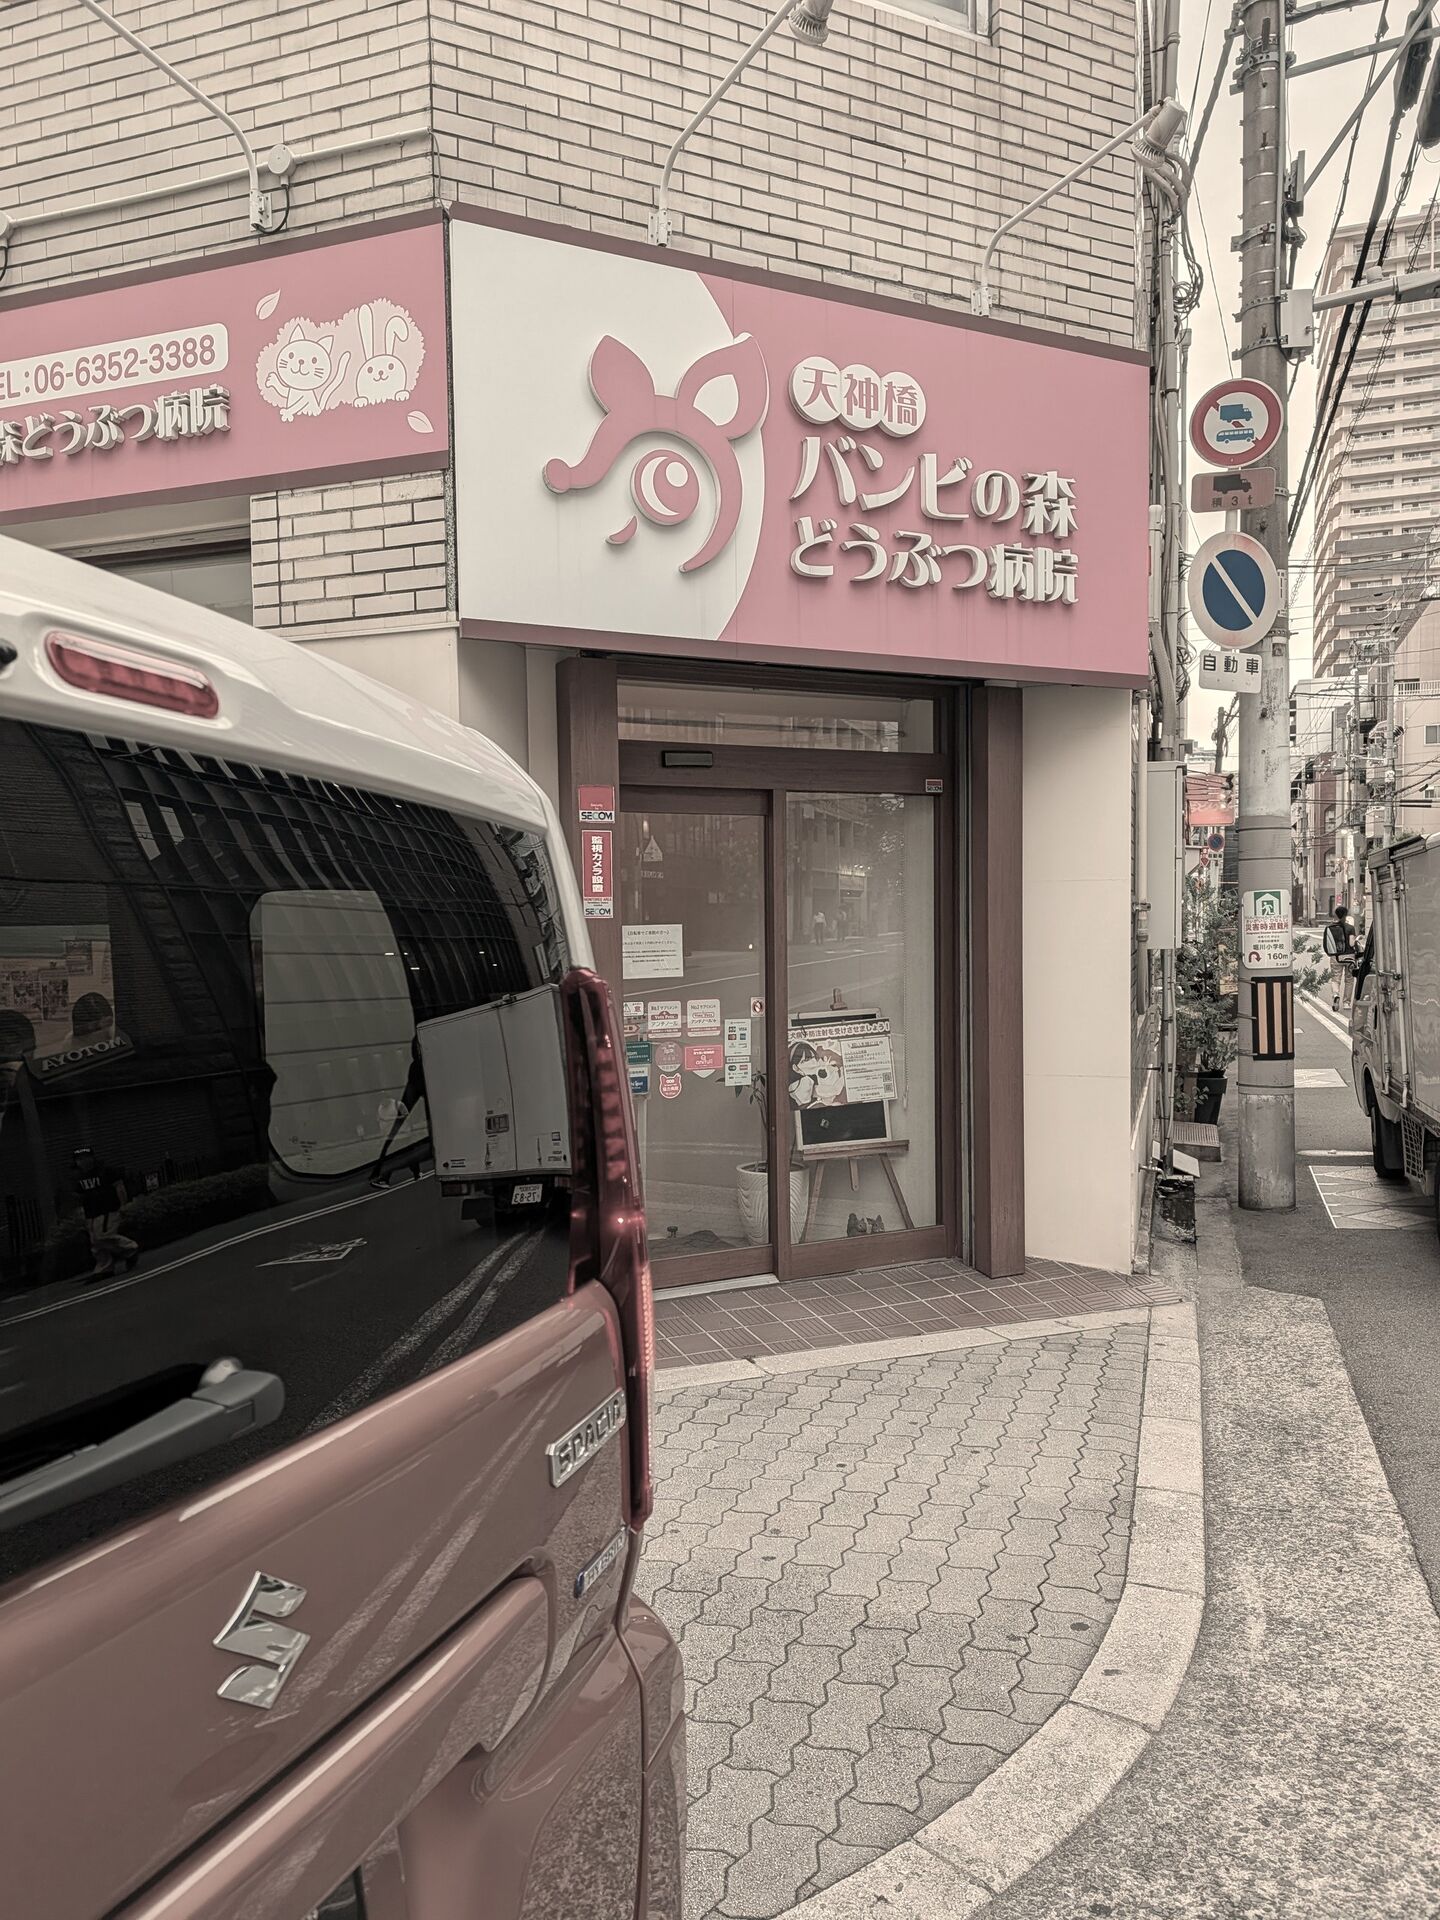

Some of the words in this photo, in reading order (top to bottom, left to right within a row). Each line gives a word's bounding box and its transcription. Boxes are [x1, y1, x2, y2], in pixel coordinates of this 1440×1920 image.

[802, 366, 918, 427] 天神橋
[790, 436, 1079, 539] バンビの森
[790, 516, 1080, 605] どうぶつ病院
[1202, 652, 1260, 675] 自動車
[581, 811, 613, 820] SECOM
[585, 908, 611, 916] SECOM
[1267, 952, 1289, 960] 160m
[557, 1398, 622, 1476] SPACIA
